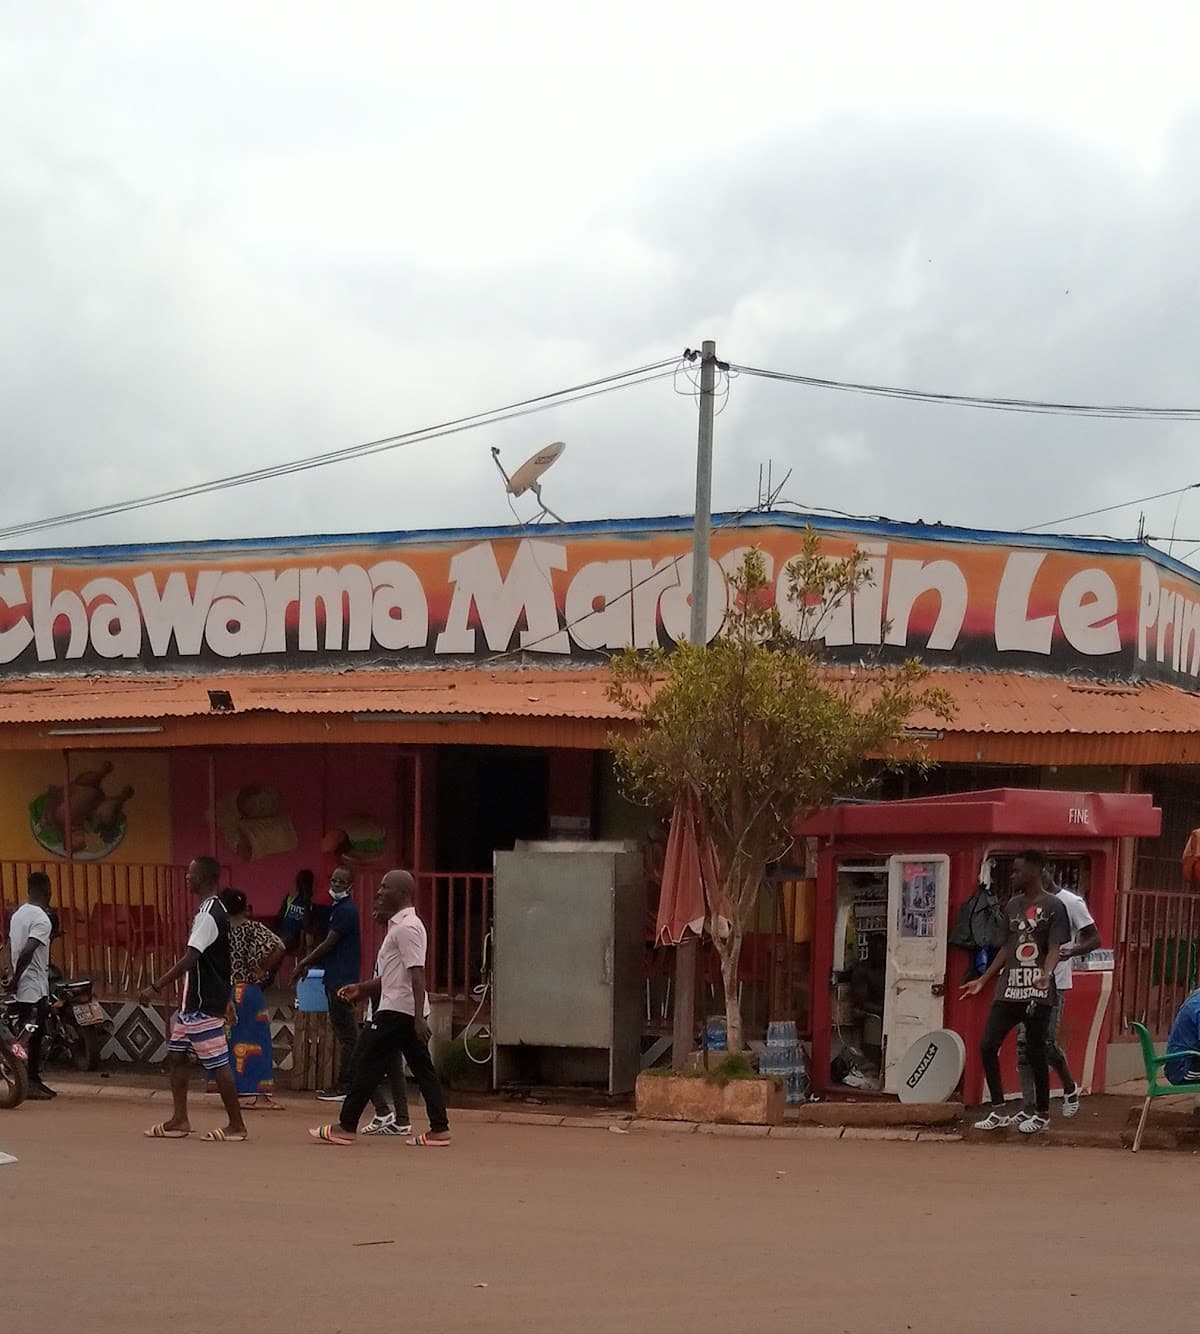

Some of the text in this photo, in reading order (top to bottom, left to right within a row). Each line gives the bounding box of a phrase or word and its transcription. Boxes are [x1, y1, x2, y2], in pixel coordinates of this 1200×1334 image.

[995, 552, 1122, 656] Le
[1138, 559, 1200, 677] Prin
[1068, 808, 1089, 825] FINE
[1007, 967, 1045, 988] MERR
[907, 1045, 937, 1087] CANAL+
